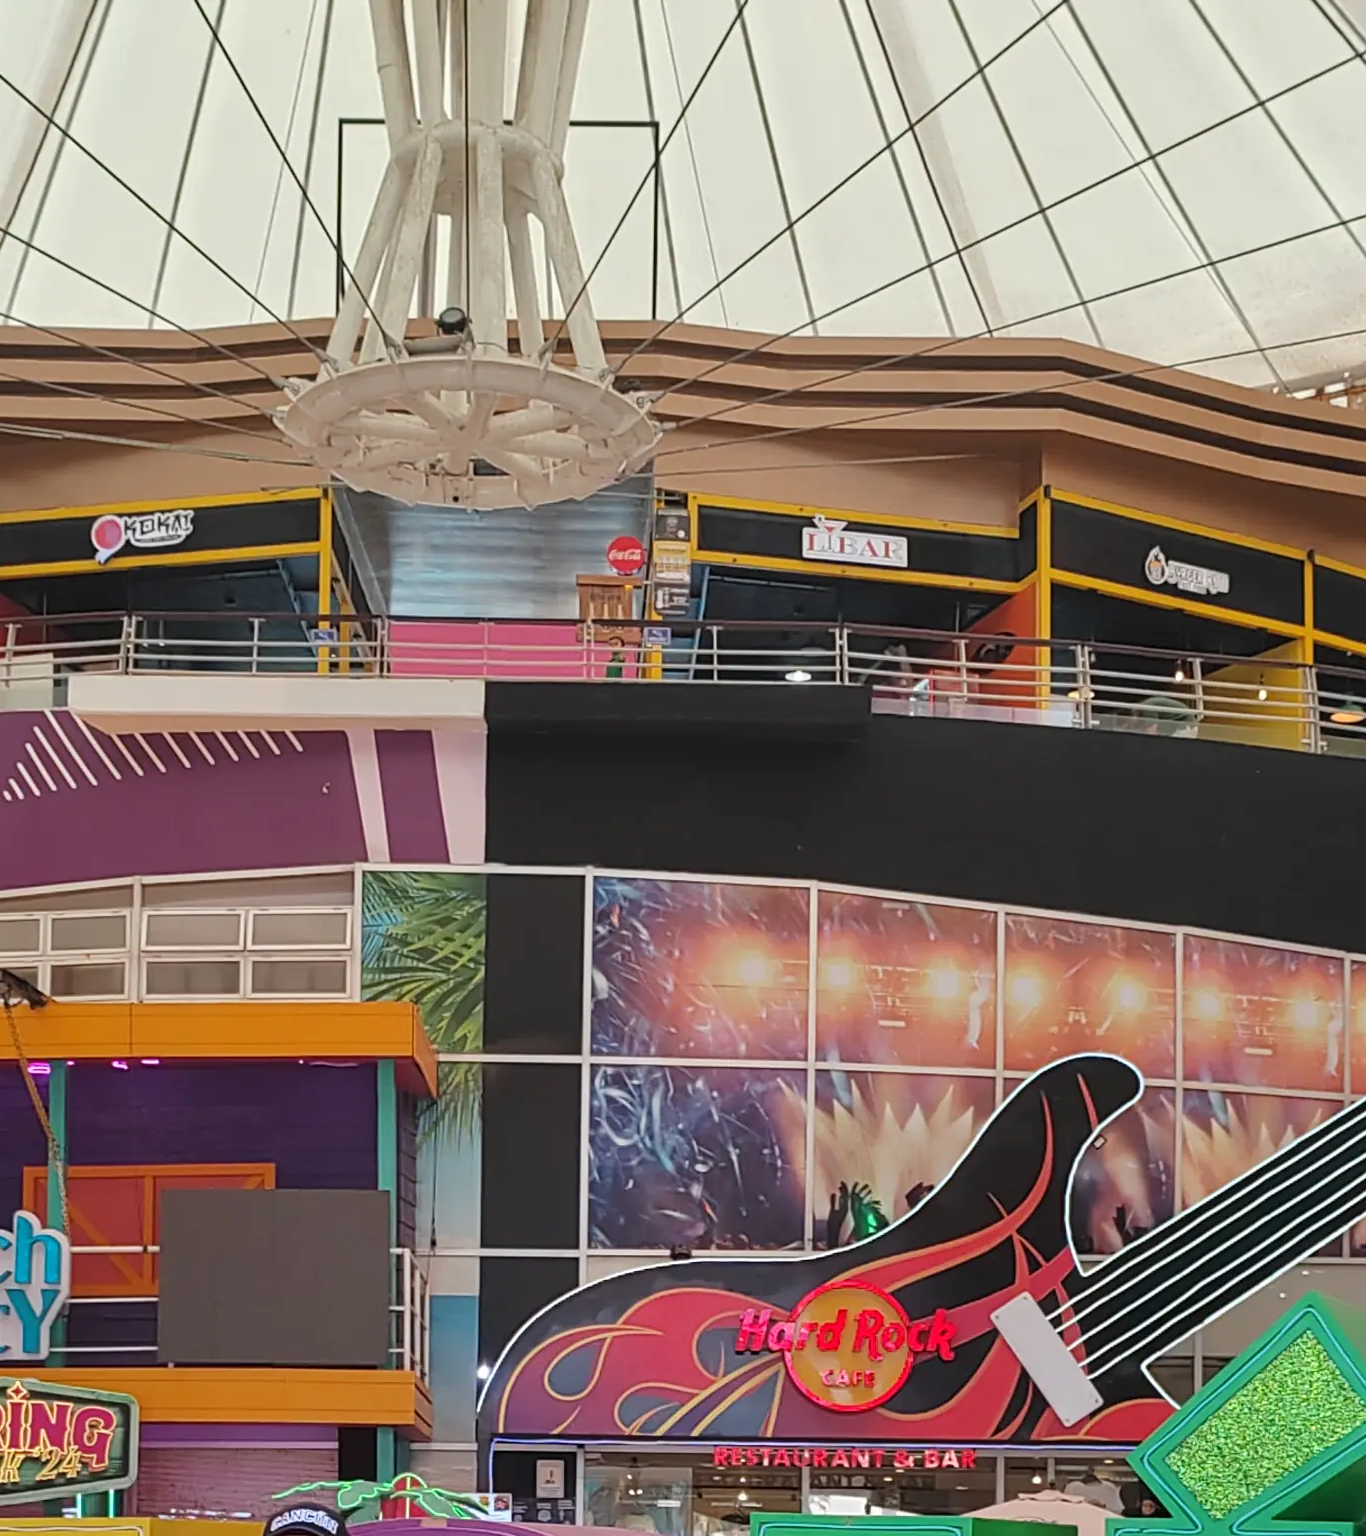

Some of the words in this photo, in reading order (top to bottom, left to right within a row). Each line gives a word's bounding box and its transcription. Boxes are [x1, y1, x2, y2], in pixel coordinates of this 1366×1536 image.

[735, 1308, 848, 1354] Hard
[852, 1308, 957, 1361] Rock
[820, 1369, 877, 1388] CAFE
[713, 1446, 885, 1468] RESTAURANT
[893, 1448, 915, 1468] &
[924, 1447, 978, 1469] BAR
